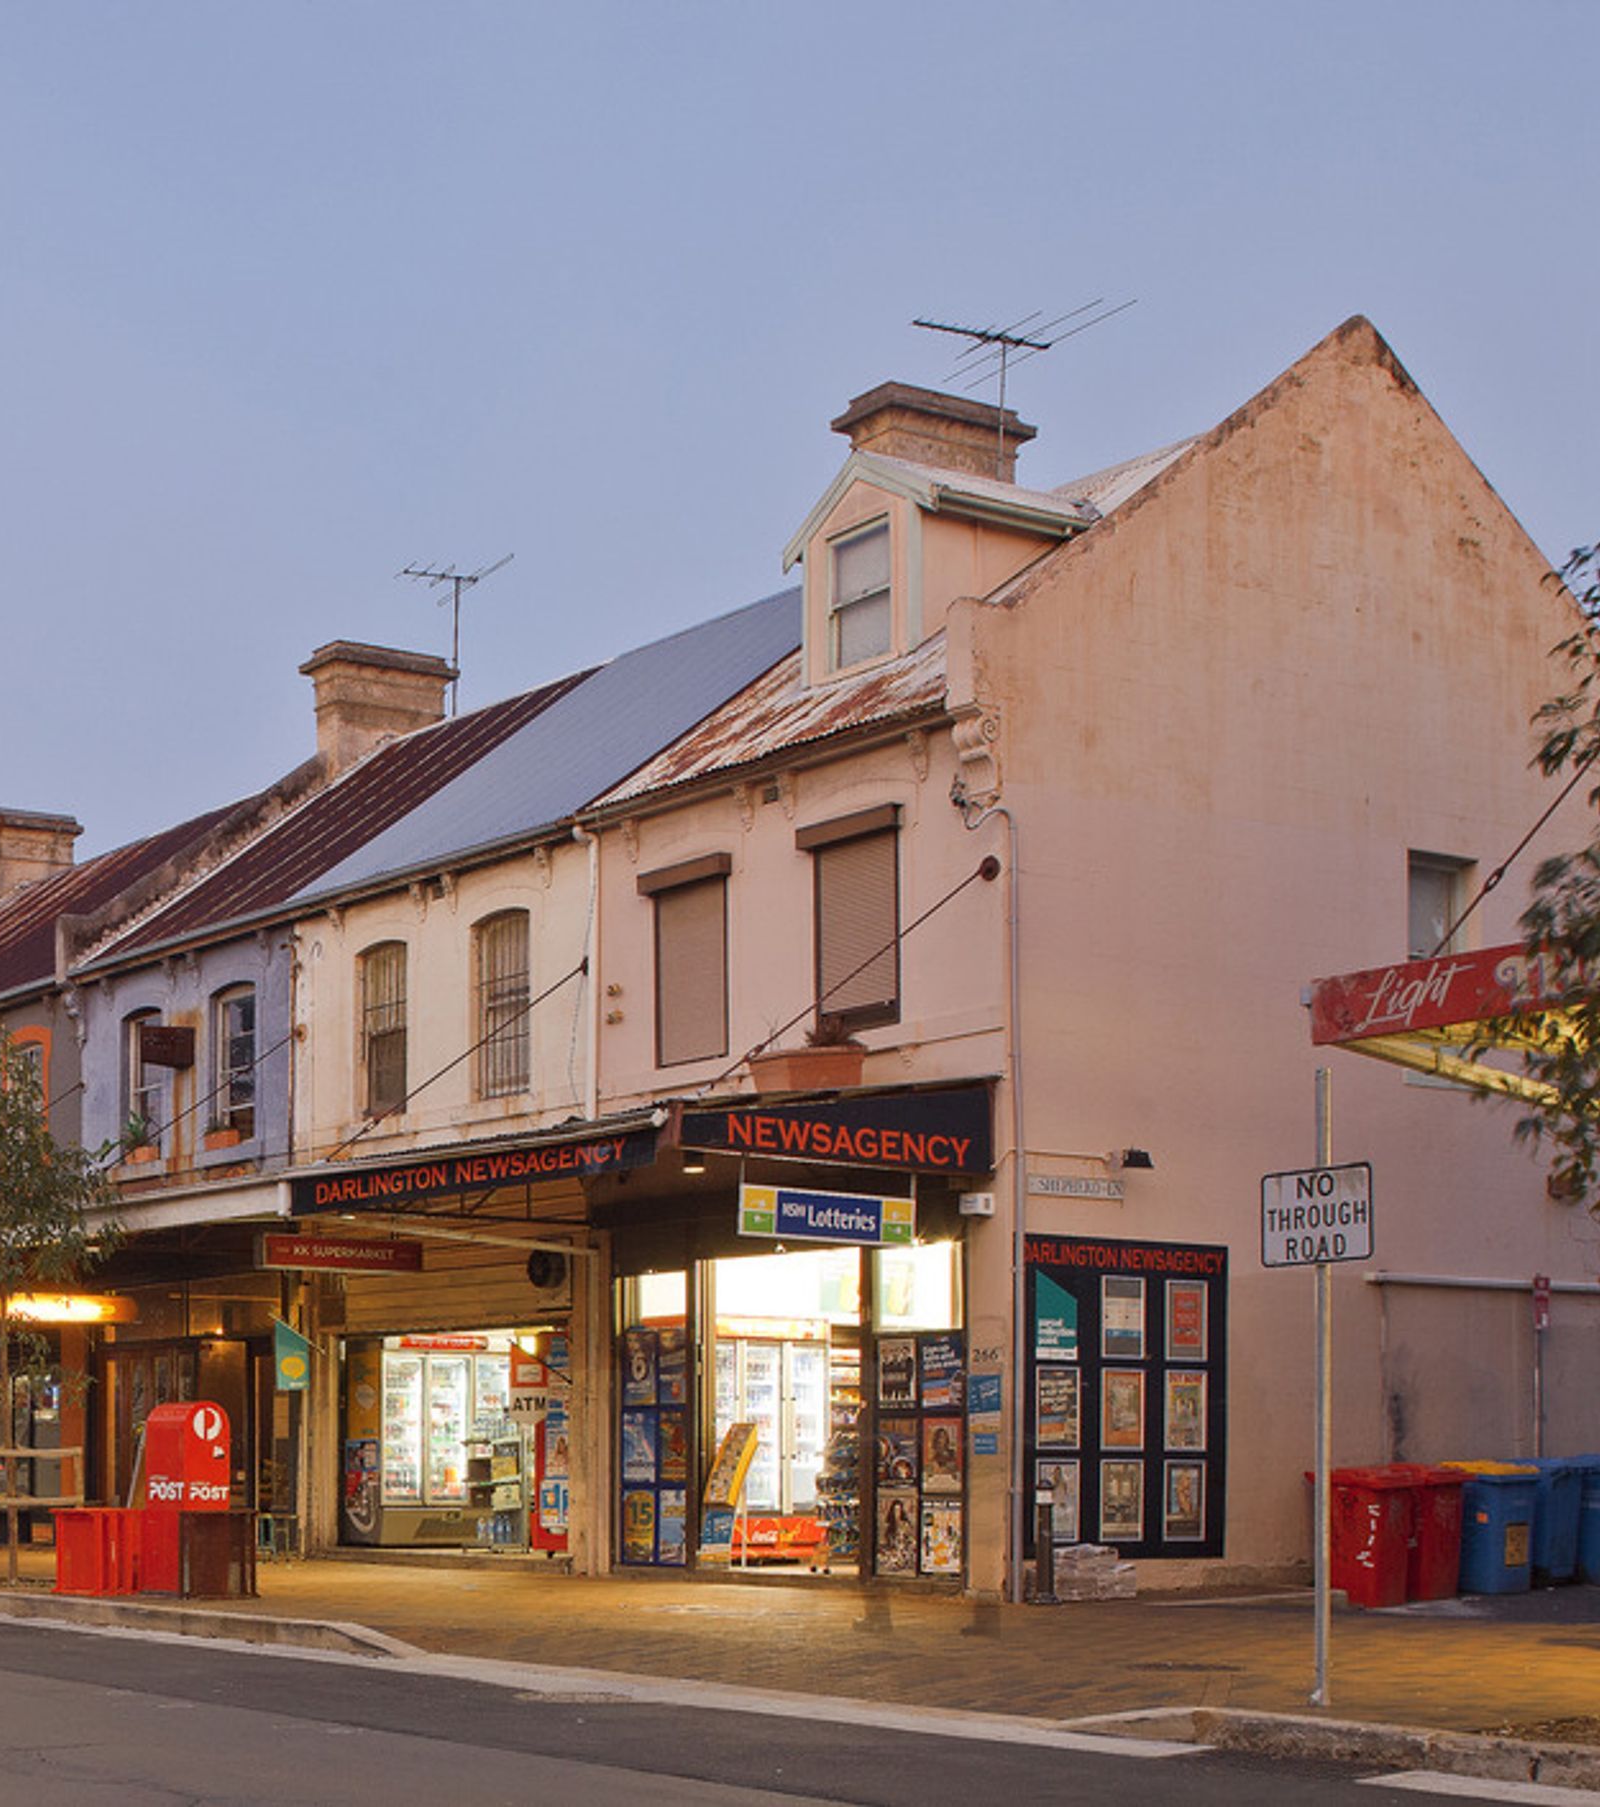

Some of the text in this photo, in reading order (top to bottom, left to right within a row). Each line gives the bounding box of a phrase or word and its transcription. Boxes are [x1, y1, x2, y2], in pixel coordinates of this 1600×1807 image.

[1353, 961, 1477, 1032] Light
[726, 1113, 971, 1167] NEWSAGENCY
[315, 1137, 627, 1205] DARLINGTON NEWSAGENCY
[1296, 1172, 1334, 1199] NO
[781, 1201, 876, 1233] NSW Lotteries
[1266, 1200, 1368, 1233] THROUGH
[312, 1245, 395, 1261] SUPERMARKET
[1024, 1241, 1224, 1275] DARLINGTON NEWSAGENCY
[1285, 1233, 1347, 1261] ROAD
[971, 1347, 999, 1363] 266
[512, 1396, 547, 1413] ATM
[149, 1481, 231, 1501] POST POST
[630, 1502, 653, 1526] 15
